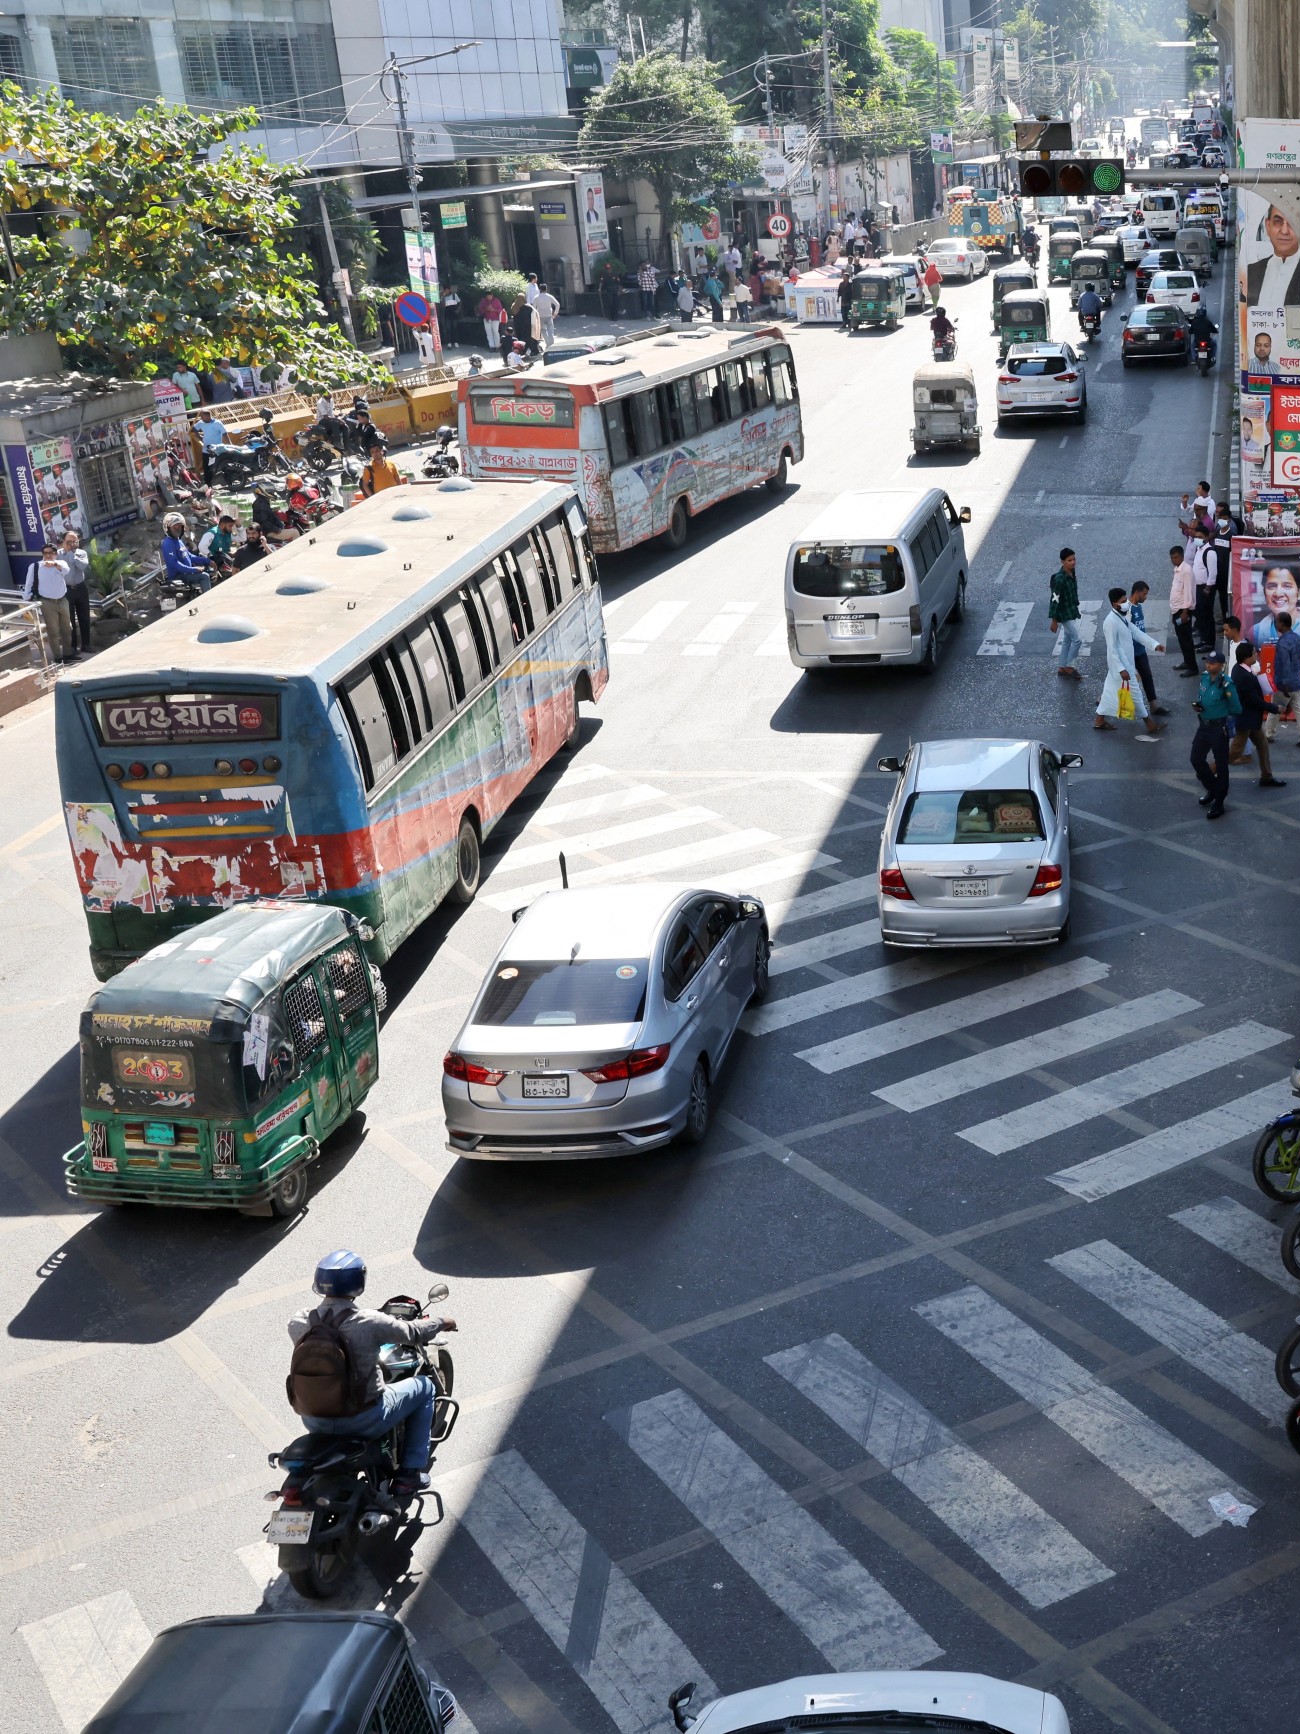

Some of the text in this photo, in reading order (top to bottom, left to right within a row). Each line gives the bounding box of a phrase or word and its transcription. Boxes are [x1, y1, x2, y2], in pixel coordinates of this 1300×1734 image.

[771, 218, 787, 232] 40
[421, 406, 456, 423] Do not
[490, 397, 556, 422] শিকড়
[25, 507, 38, 533] সার্ভিস
[109, 703, 239, 731] দেওয়ান
